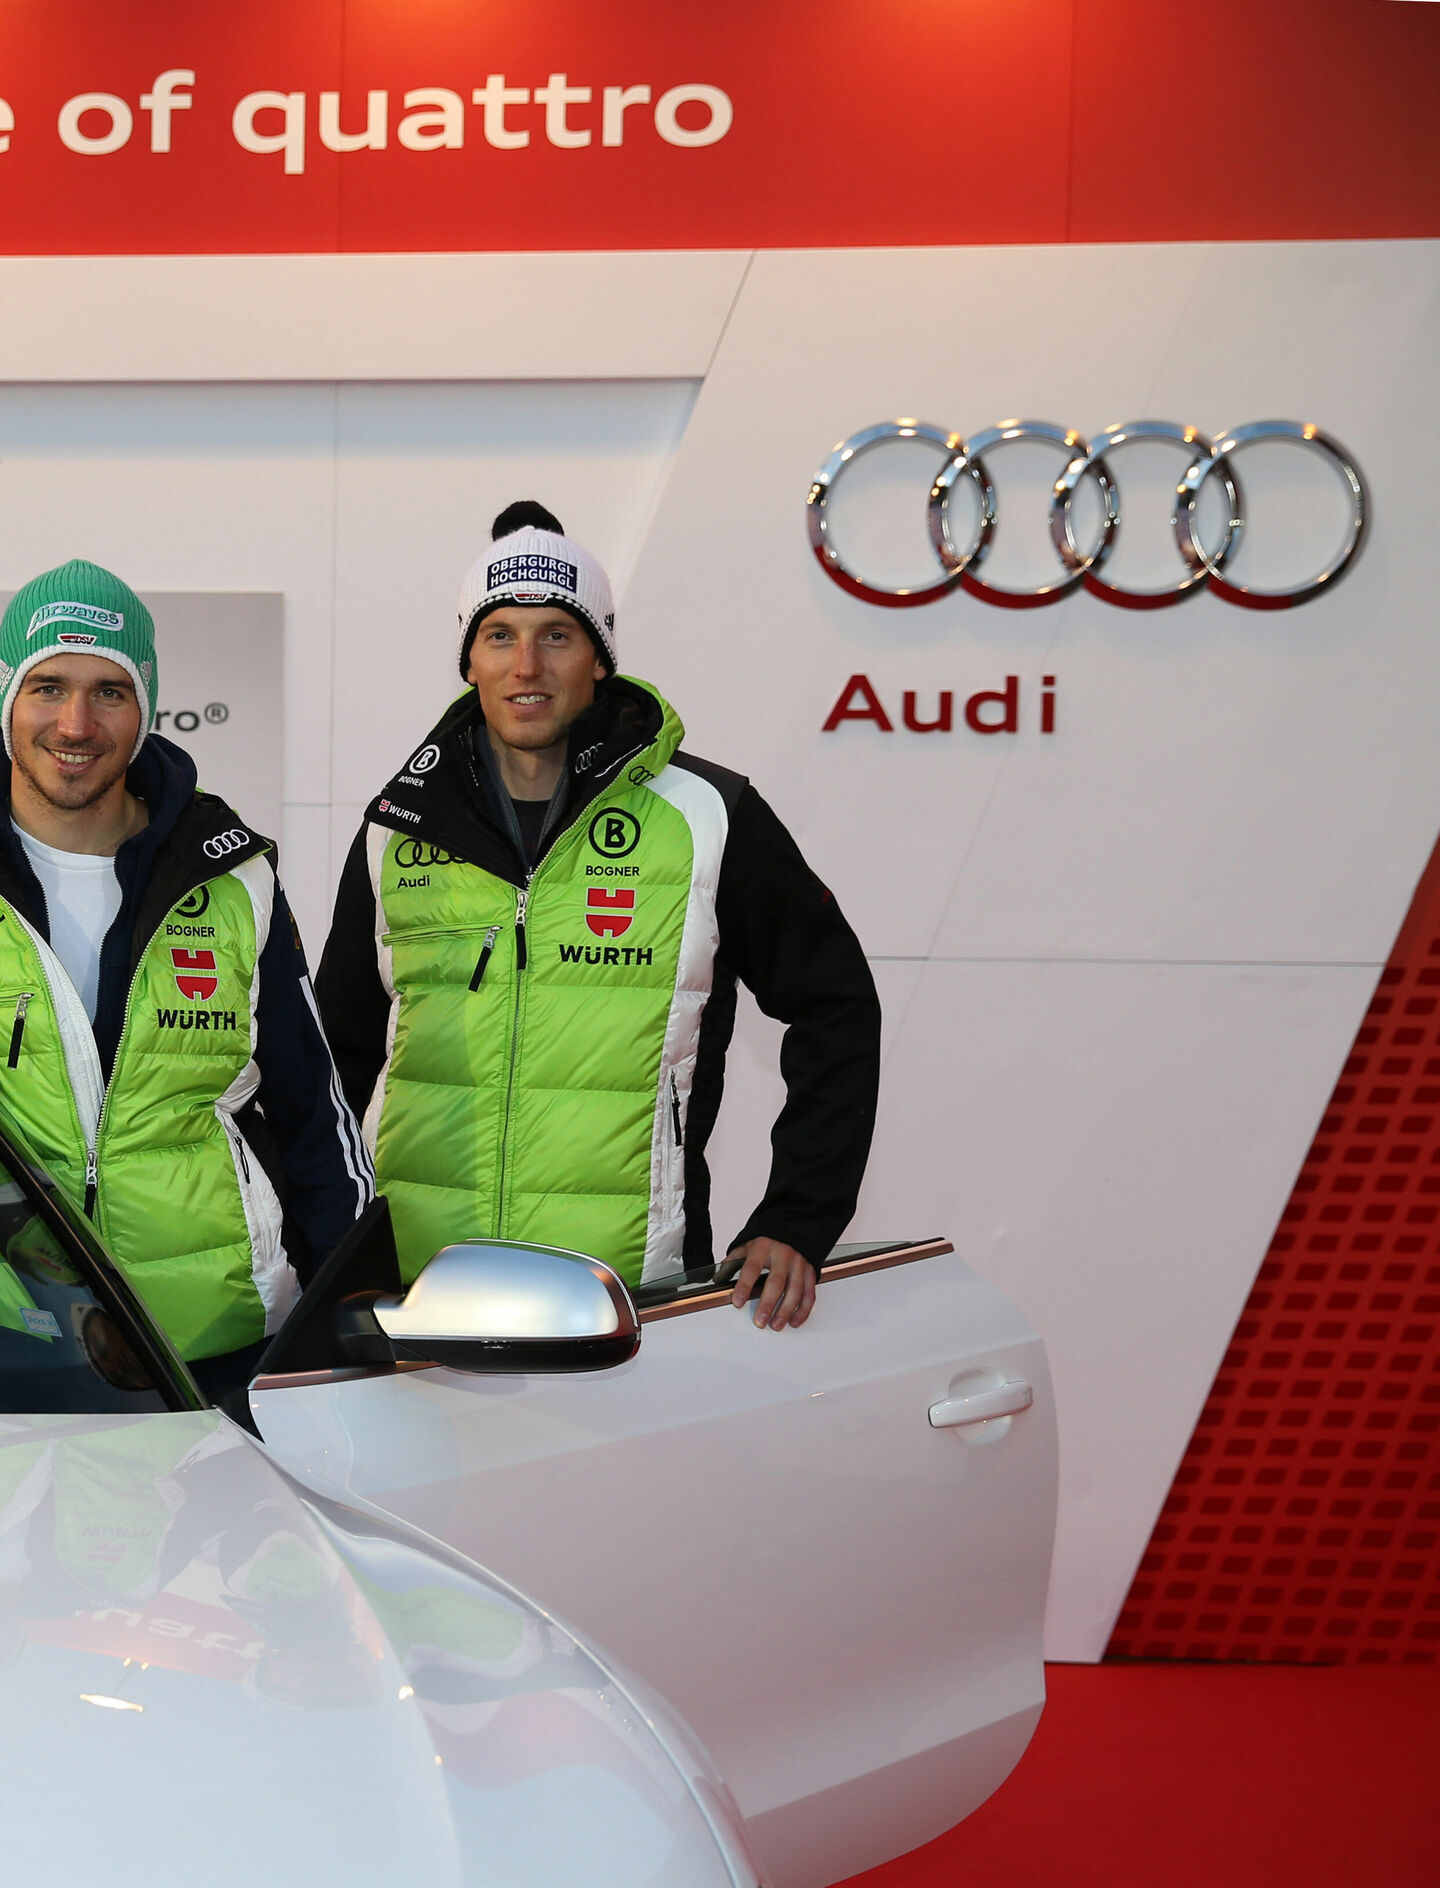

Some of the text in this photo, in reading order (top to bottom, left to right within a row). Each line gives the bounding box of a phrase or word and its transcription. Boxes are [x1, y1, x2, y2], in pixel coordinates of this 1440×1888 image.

[56, 69, 196, 155] of
[231, 72, 734, 175] quattro
[491, 556, 574, 577] OBERGURGL
[490, 569, 574, 590] HOCHGURGL
[33, 604, 120, 626] Airwaves
[821, 674, 1056, 734] Audi
[398, 775, 425, 787] BOGNER
[397, 874, 430, 889] Audi
[585, 865, 641, 877] BOGNER
[166, 924, 216, 938] BOGNER
[559, 944, 653, 966] WÜRTH
[157, 1008, 237, 1031] WÜRTH
